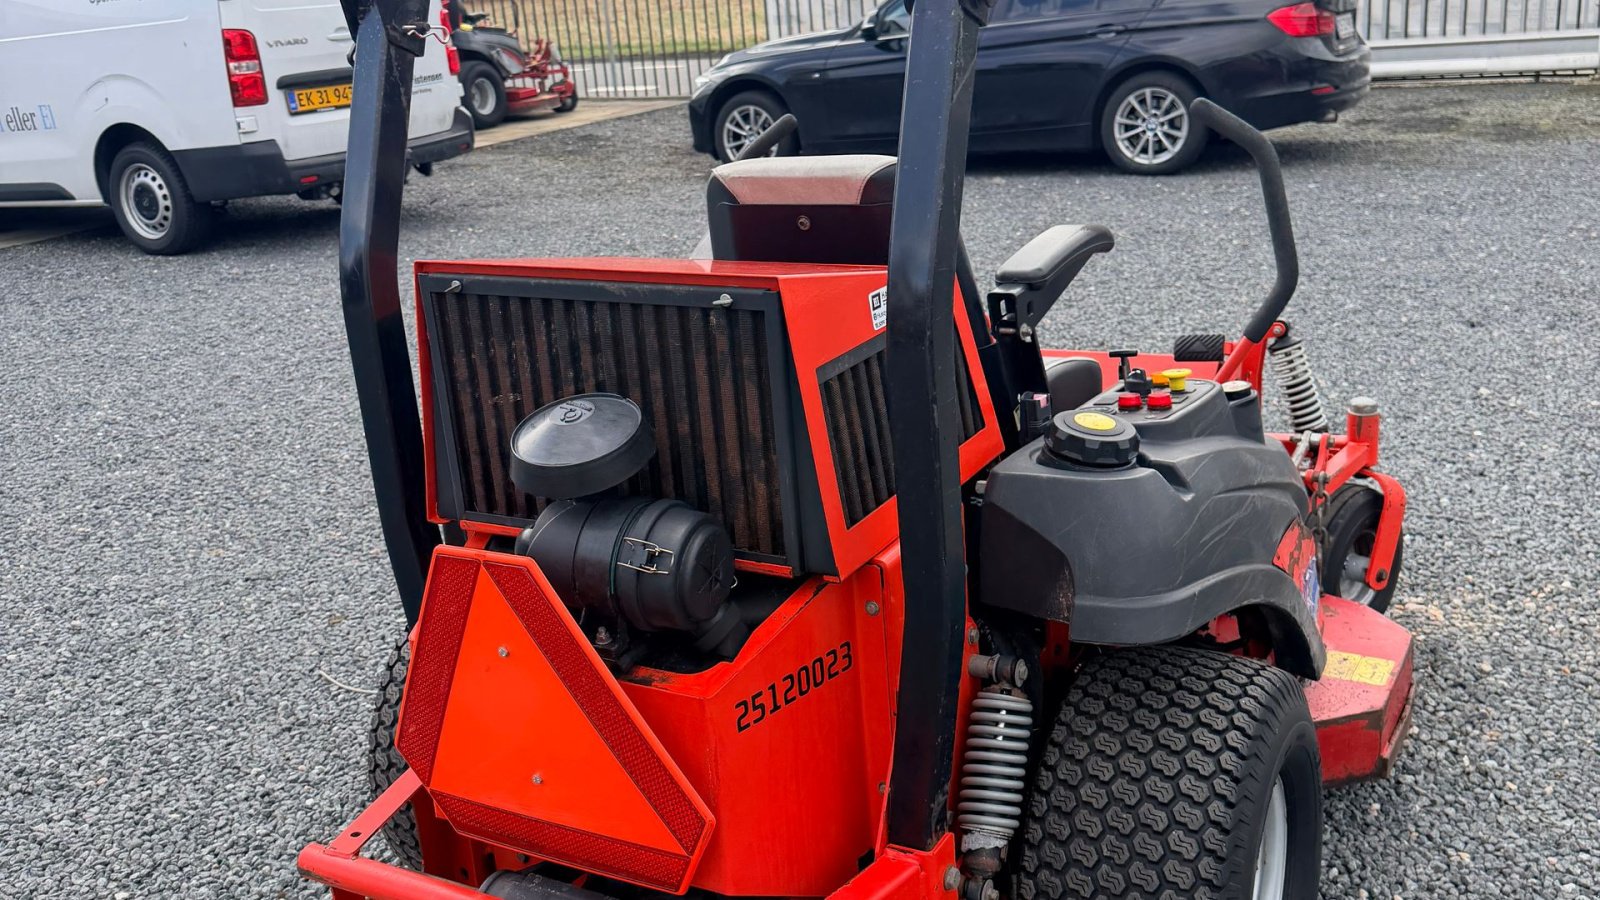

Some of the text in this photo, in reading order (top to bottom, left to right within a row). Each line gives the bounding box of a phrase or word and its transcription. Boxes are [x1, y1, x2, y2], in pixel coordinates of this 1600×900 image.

[265, 37, 309, 48] VIVARO
[297, 91, 315, 107] EK
[316, 90, 331, 105] 31
[5, 106, 38, 132] eller
[37, 104, 57, 130] El
[734, 640, 853, 733] 25120023
